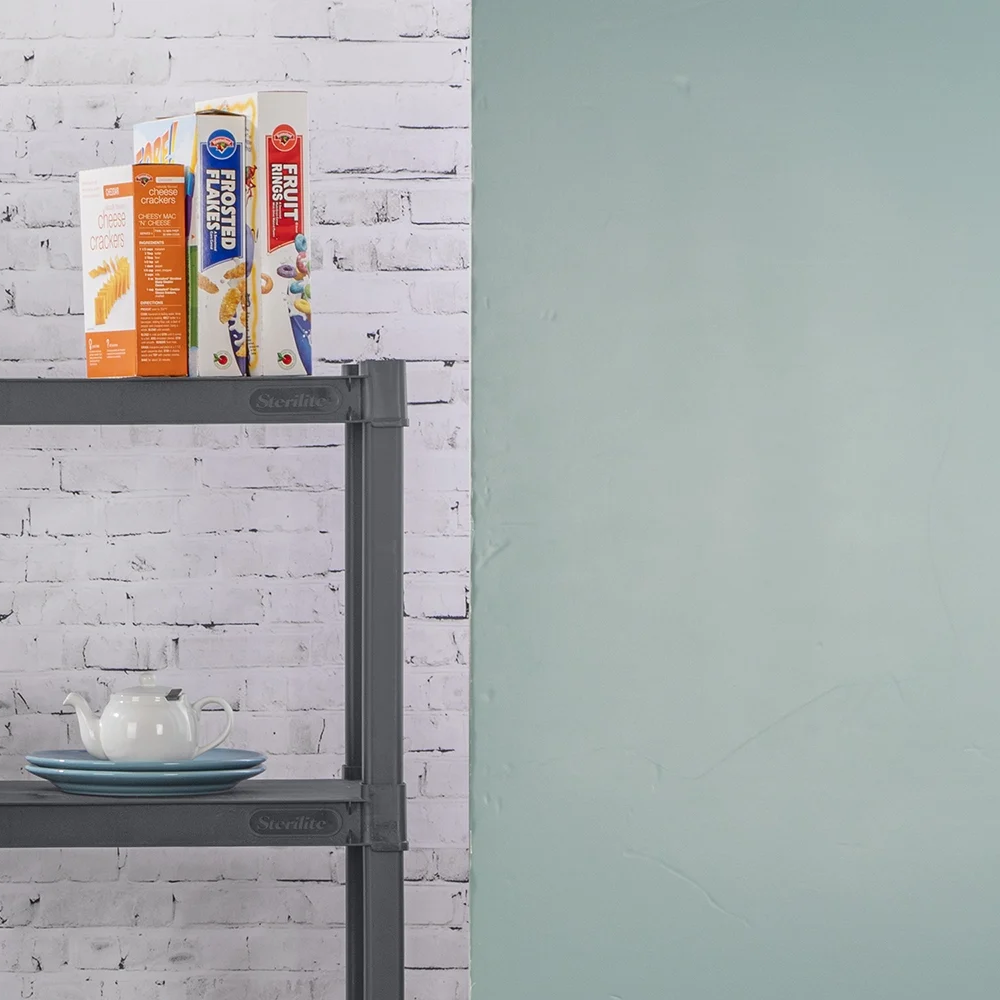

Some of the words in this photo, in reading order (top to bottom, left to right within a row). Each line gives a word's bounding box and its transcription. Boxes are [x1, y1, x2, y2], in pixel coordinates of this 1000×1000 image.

[148, 188, 178, 196] cheese
[271, 163, 283, 202] RINGS
[283, 163, 299, 222] FRUIT
[140, 196, 176, 204] crackers
[206, 169, 220, 231] FLAKES
[221, 169, 236, 250] FROSTED
[98, 210, 126, 229] cheese
[90, 229, 125, 251] crackers
[256, 393, 327, 408] Sterilite
[257, 815, 327, 830] Sterilite
